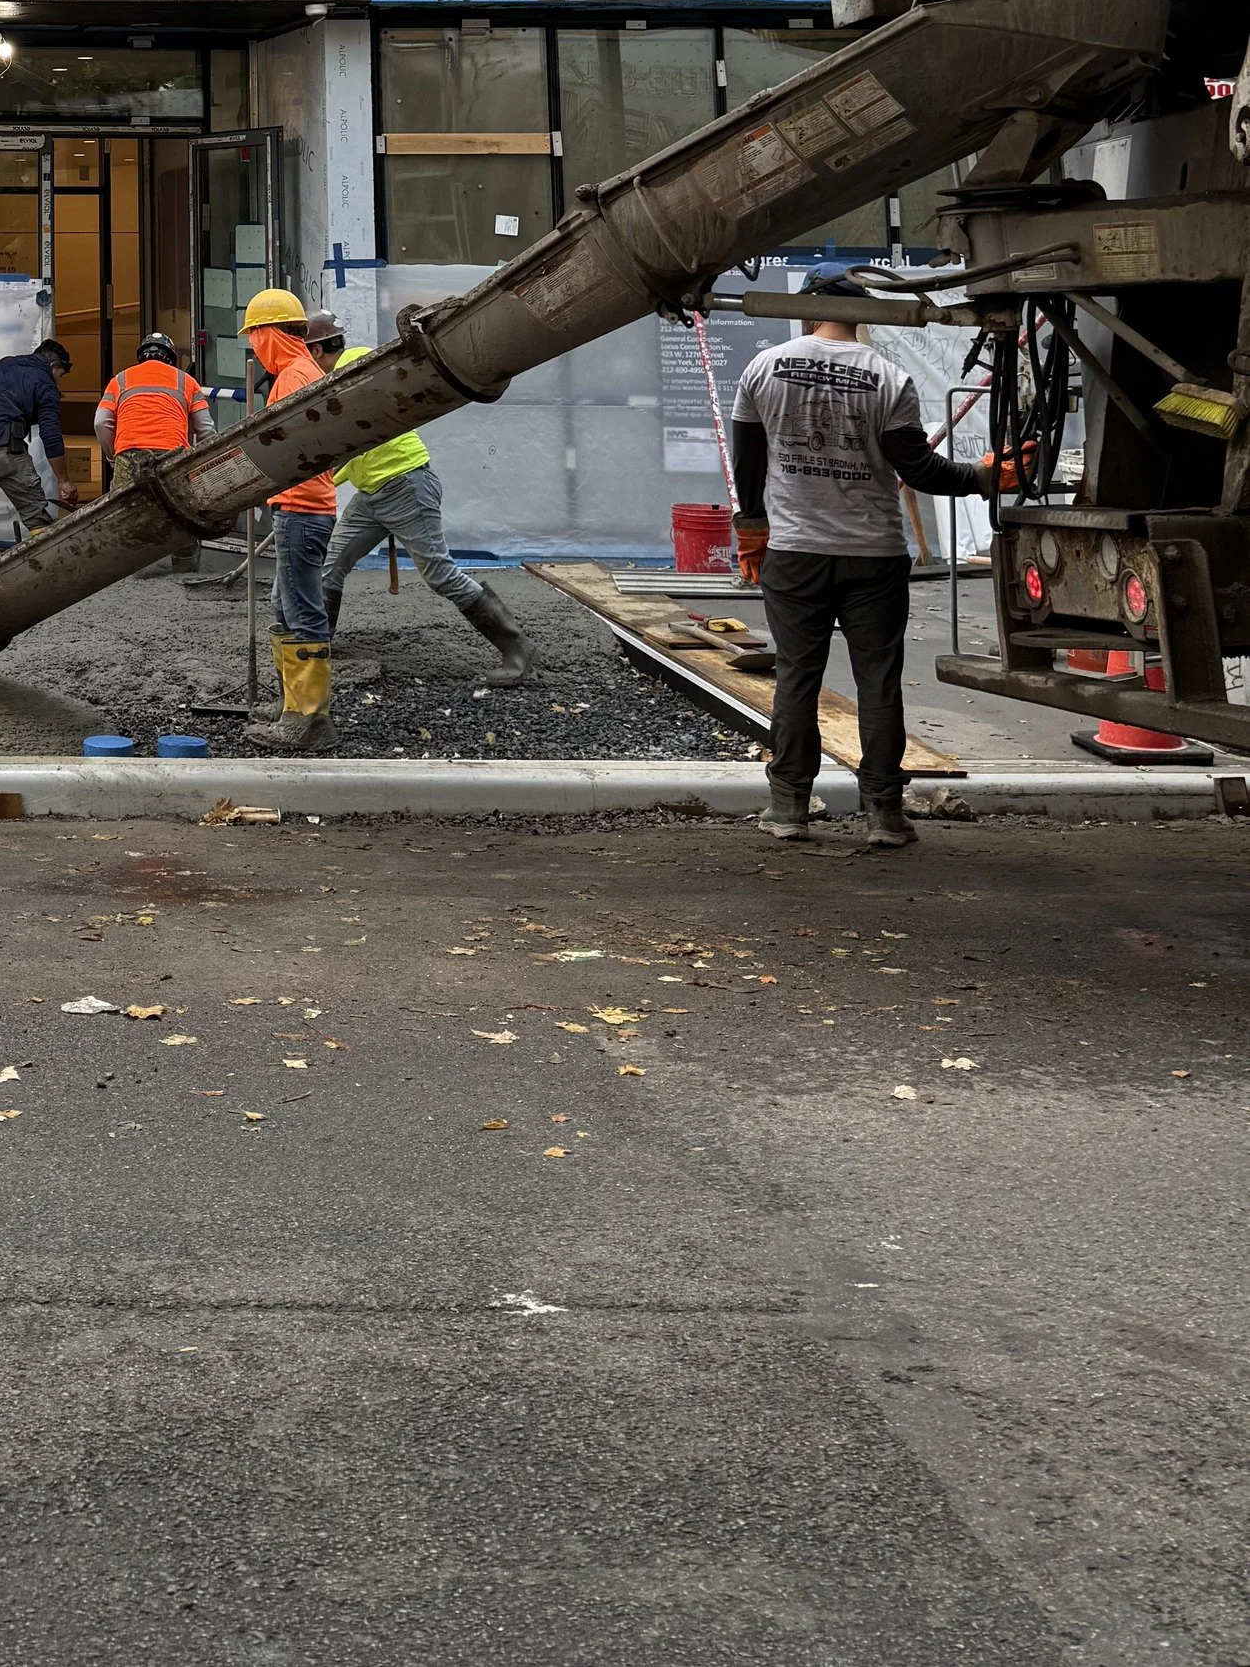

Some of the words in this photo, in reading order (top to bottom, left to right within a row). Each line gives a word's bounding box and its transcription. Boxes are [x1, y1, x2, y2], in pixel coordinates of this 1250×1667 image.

[339, 44, 347, 79] ALPOLIC
[340, 109, 349, 143] ALPOLIC
[342, 174, 350, 209] ALPOLIC
[285, 246, 319, 303] ALPOLIC
[710, 318, 755, 326] Information:
[660, 335, 686, 343] General
[678, 359, 695, 367] York,
[790, 371, 832, 383] READY
[835, 377, 859, 387] MIX
[791, 454, 816, 465] FAILE
